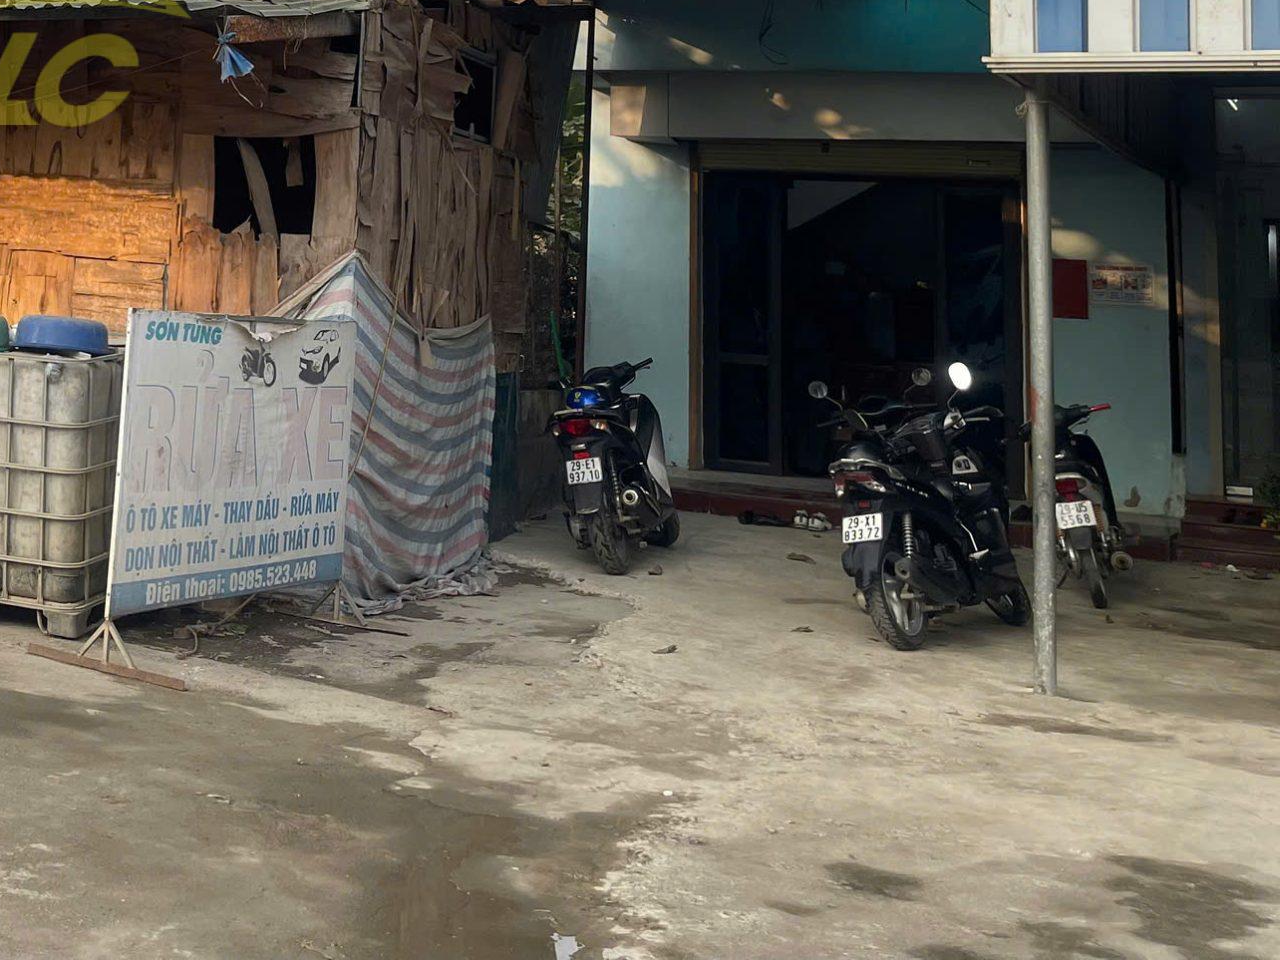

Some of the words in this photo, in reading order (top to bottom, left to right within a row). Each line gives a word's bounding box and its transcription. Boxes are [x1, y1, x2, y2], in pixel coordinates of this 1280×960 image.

[145, 318, 179, 341] SƠN
[275, 385, 348, 484] XE
[126, 503, 136, 533] Ô
[140, 502, 157, 532] TÔ
[160, 505, 178, 530] XE
[181, 499, 211, 528] MÁY
[224, 500, 253, 524] THAY
[290, 488, 312, 517] RỬA
[315, 488, 339, 514] MÁY
[125, 545, 155, 576] DỌN
[158, 538, 182, 572] NỘI
[186, 531, 218, 564] THẤT
[229, 532, 256, 559] LÀM
[259, 528, 279, 559] NỘI
[283, 521, 310, 552] THẤT
[312, 522, 320, 548] Ô
[323, 521, 336, 546] TÔ
[145, 582, 180, 607] Điện
[229, 559, 317, 592] 0985.523.448
